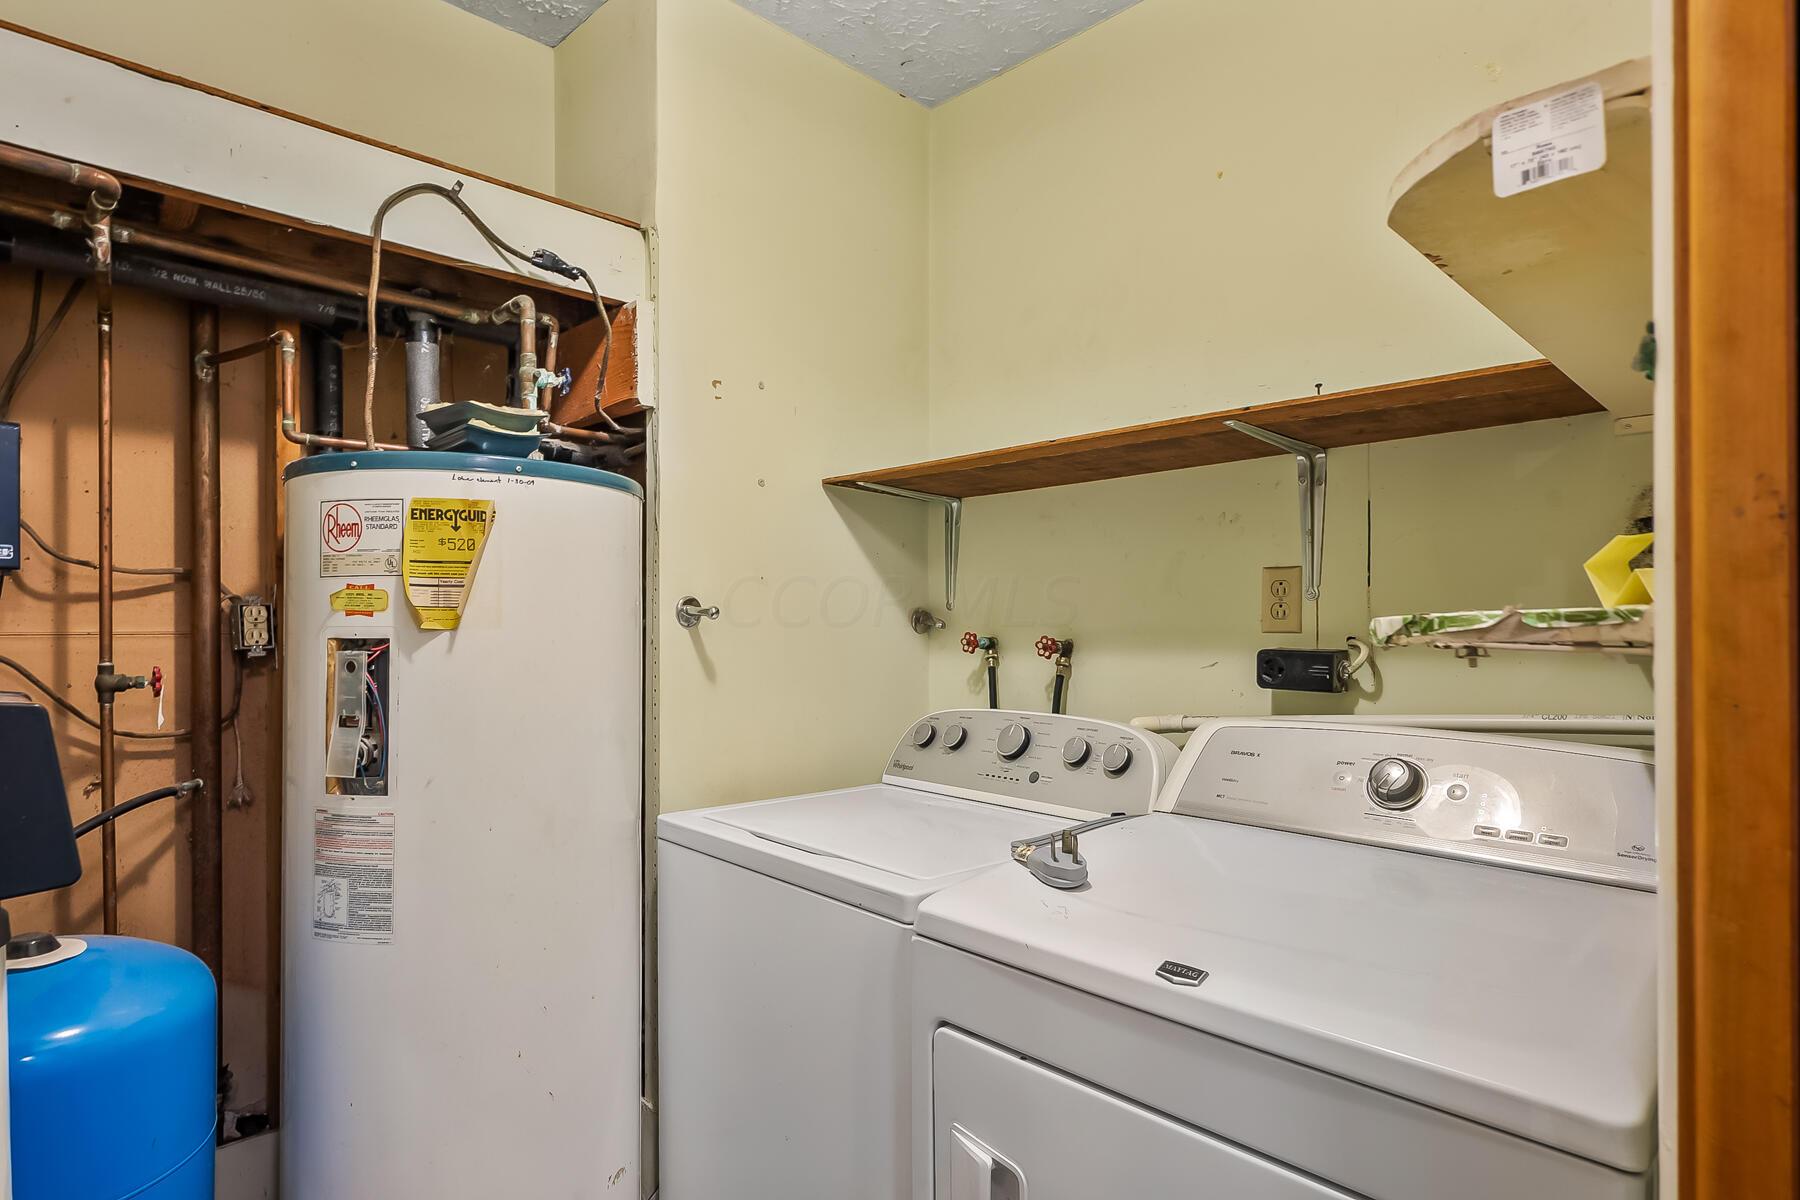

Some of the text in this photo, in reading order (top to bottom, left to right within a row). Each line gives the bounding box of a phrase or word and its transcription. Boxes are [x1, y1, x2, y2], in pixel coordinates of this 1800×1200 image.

[327, 506, 360, 544] Rheem
[438, 537, 476, 552] $520
[1163, 963, 1200, 978] MAYTAG
